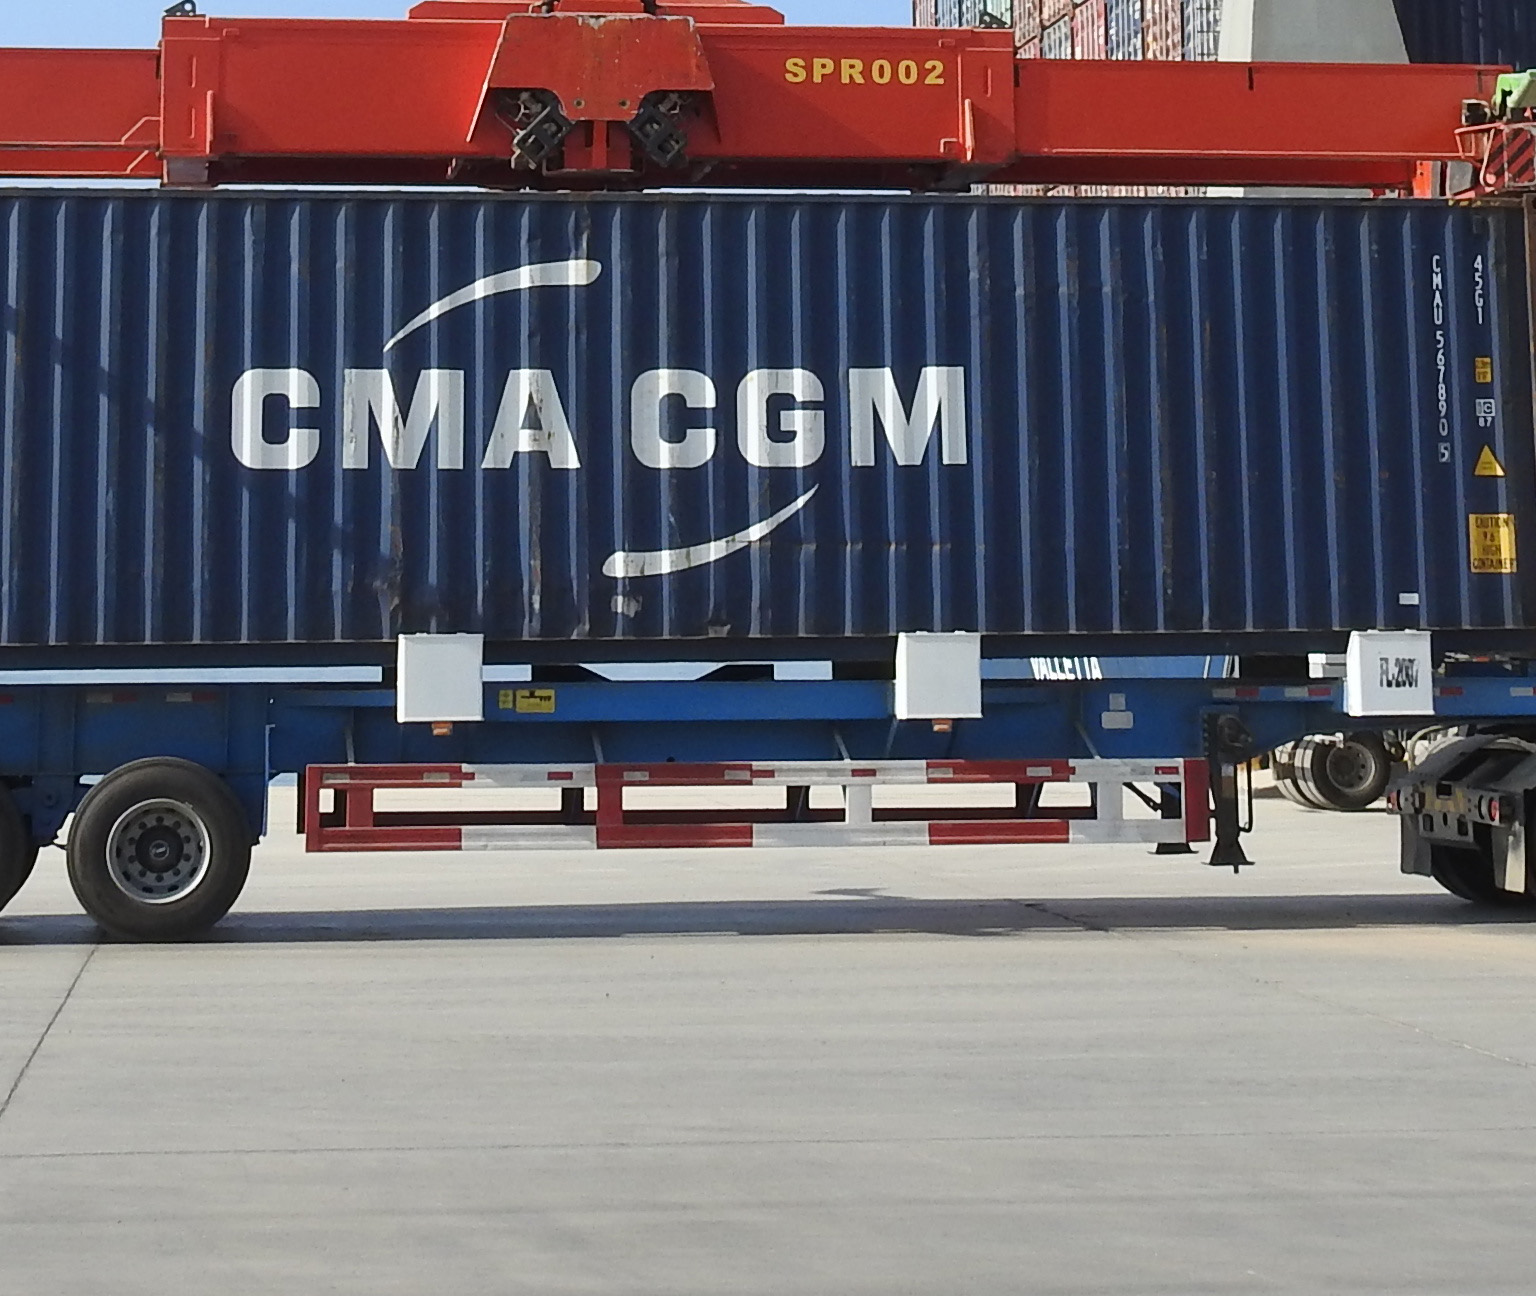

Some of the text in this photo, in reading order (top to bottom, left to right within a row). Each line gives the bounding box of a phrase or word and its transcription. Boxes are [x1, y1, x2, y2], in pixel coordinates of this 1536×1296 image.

[785, 57, 945, 85] SPR002
[1473, 255, 1484, 324] 45G1
[1432, 255, 1449, 460] CMAU 567890 5
[231, 366, 968, 471] CMA CGM
